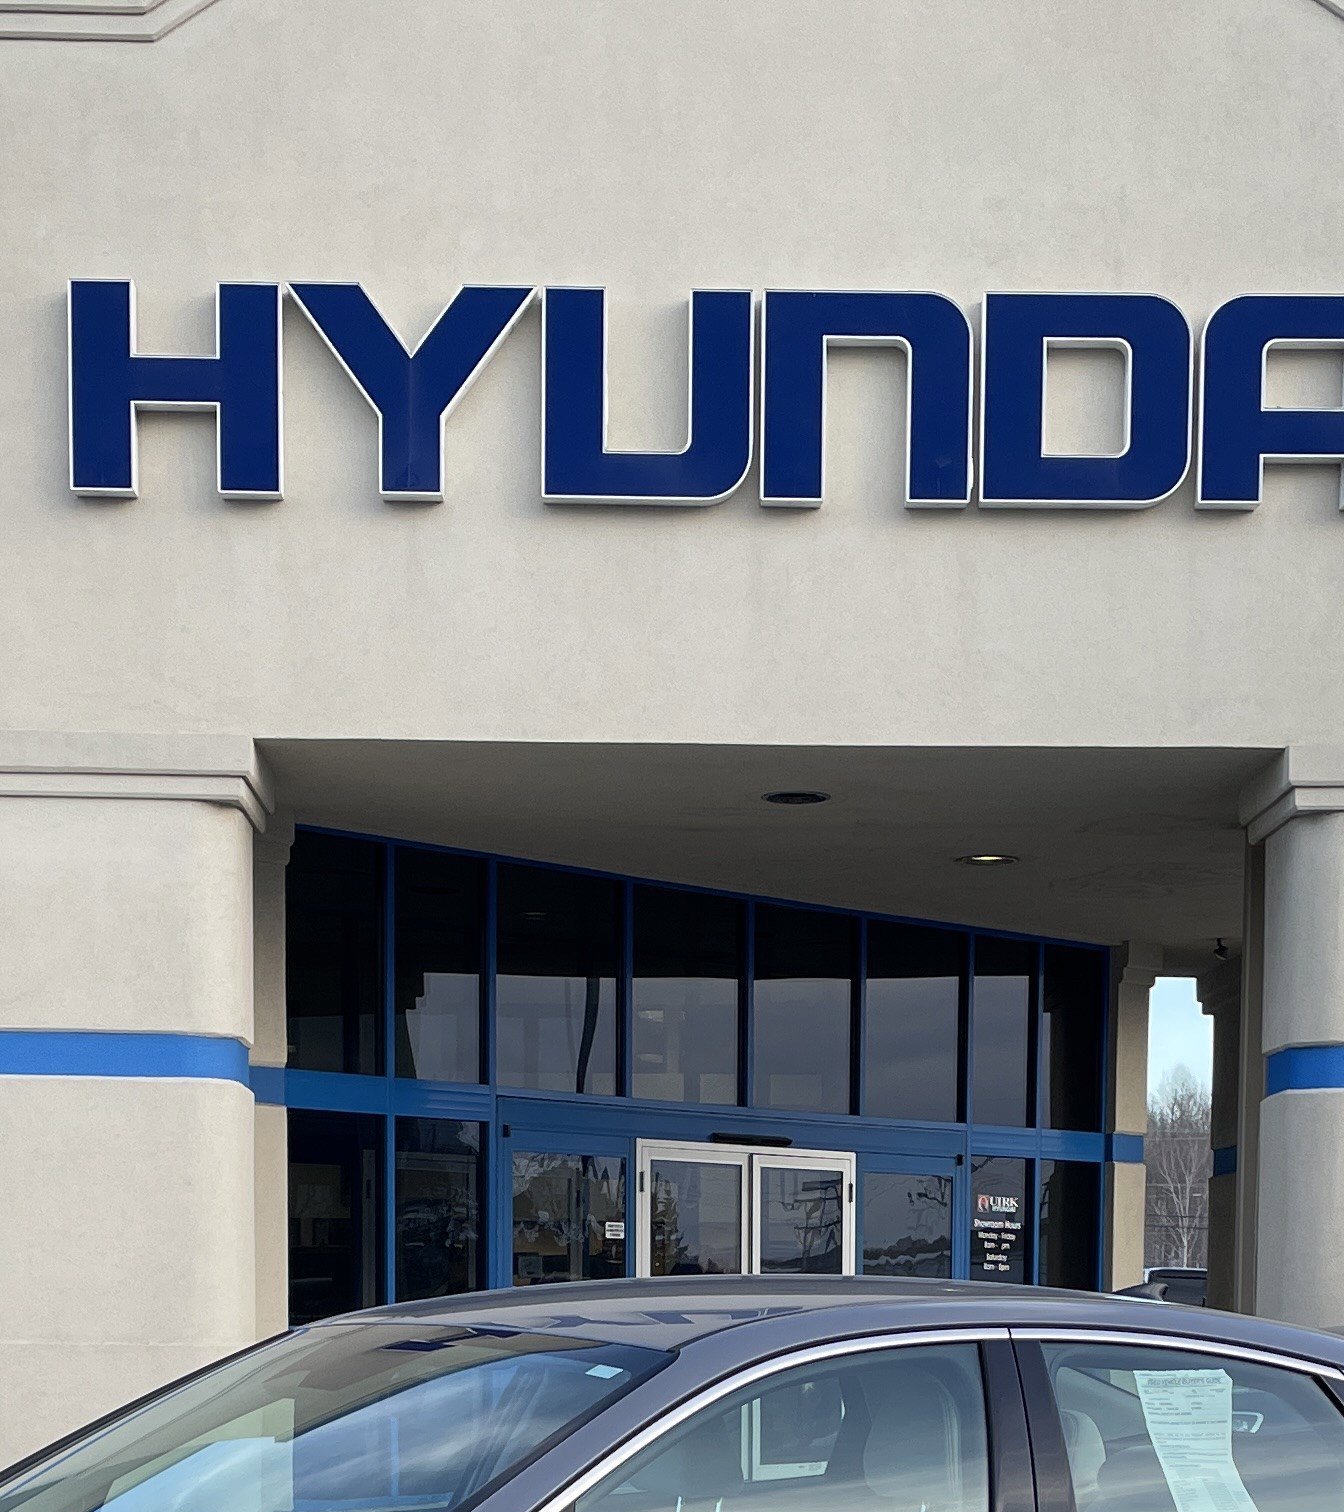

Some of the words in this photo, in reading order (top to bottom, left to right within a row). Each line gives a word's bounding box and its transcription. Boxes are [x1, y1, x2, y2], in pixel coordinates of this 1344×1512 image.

[977, 1195, 1018, 1213] QUIRK
[974, 1218, 1004, 1228] Showroom
[1005, 1220, 1021, 1230] Hours
[978, 1231, 998, 1241] Monday
[986, 1253, 1008, 1262] Saturday
